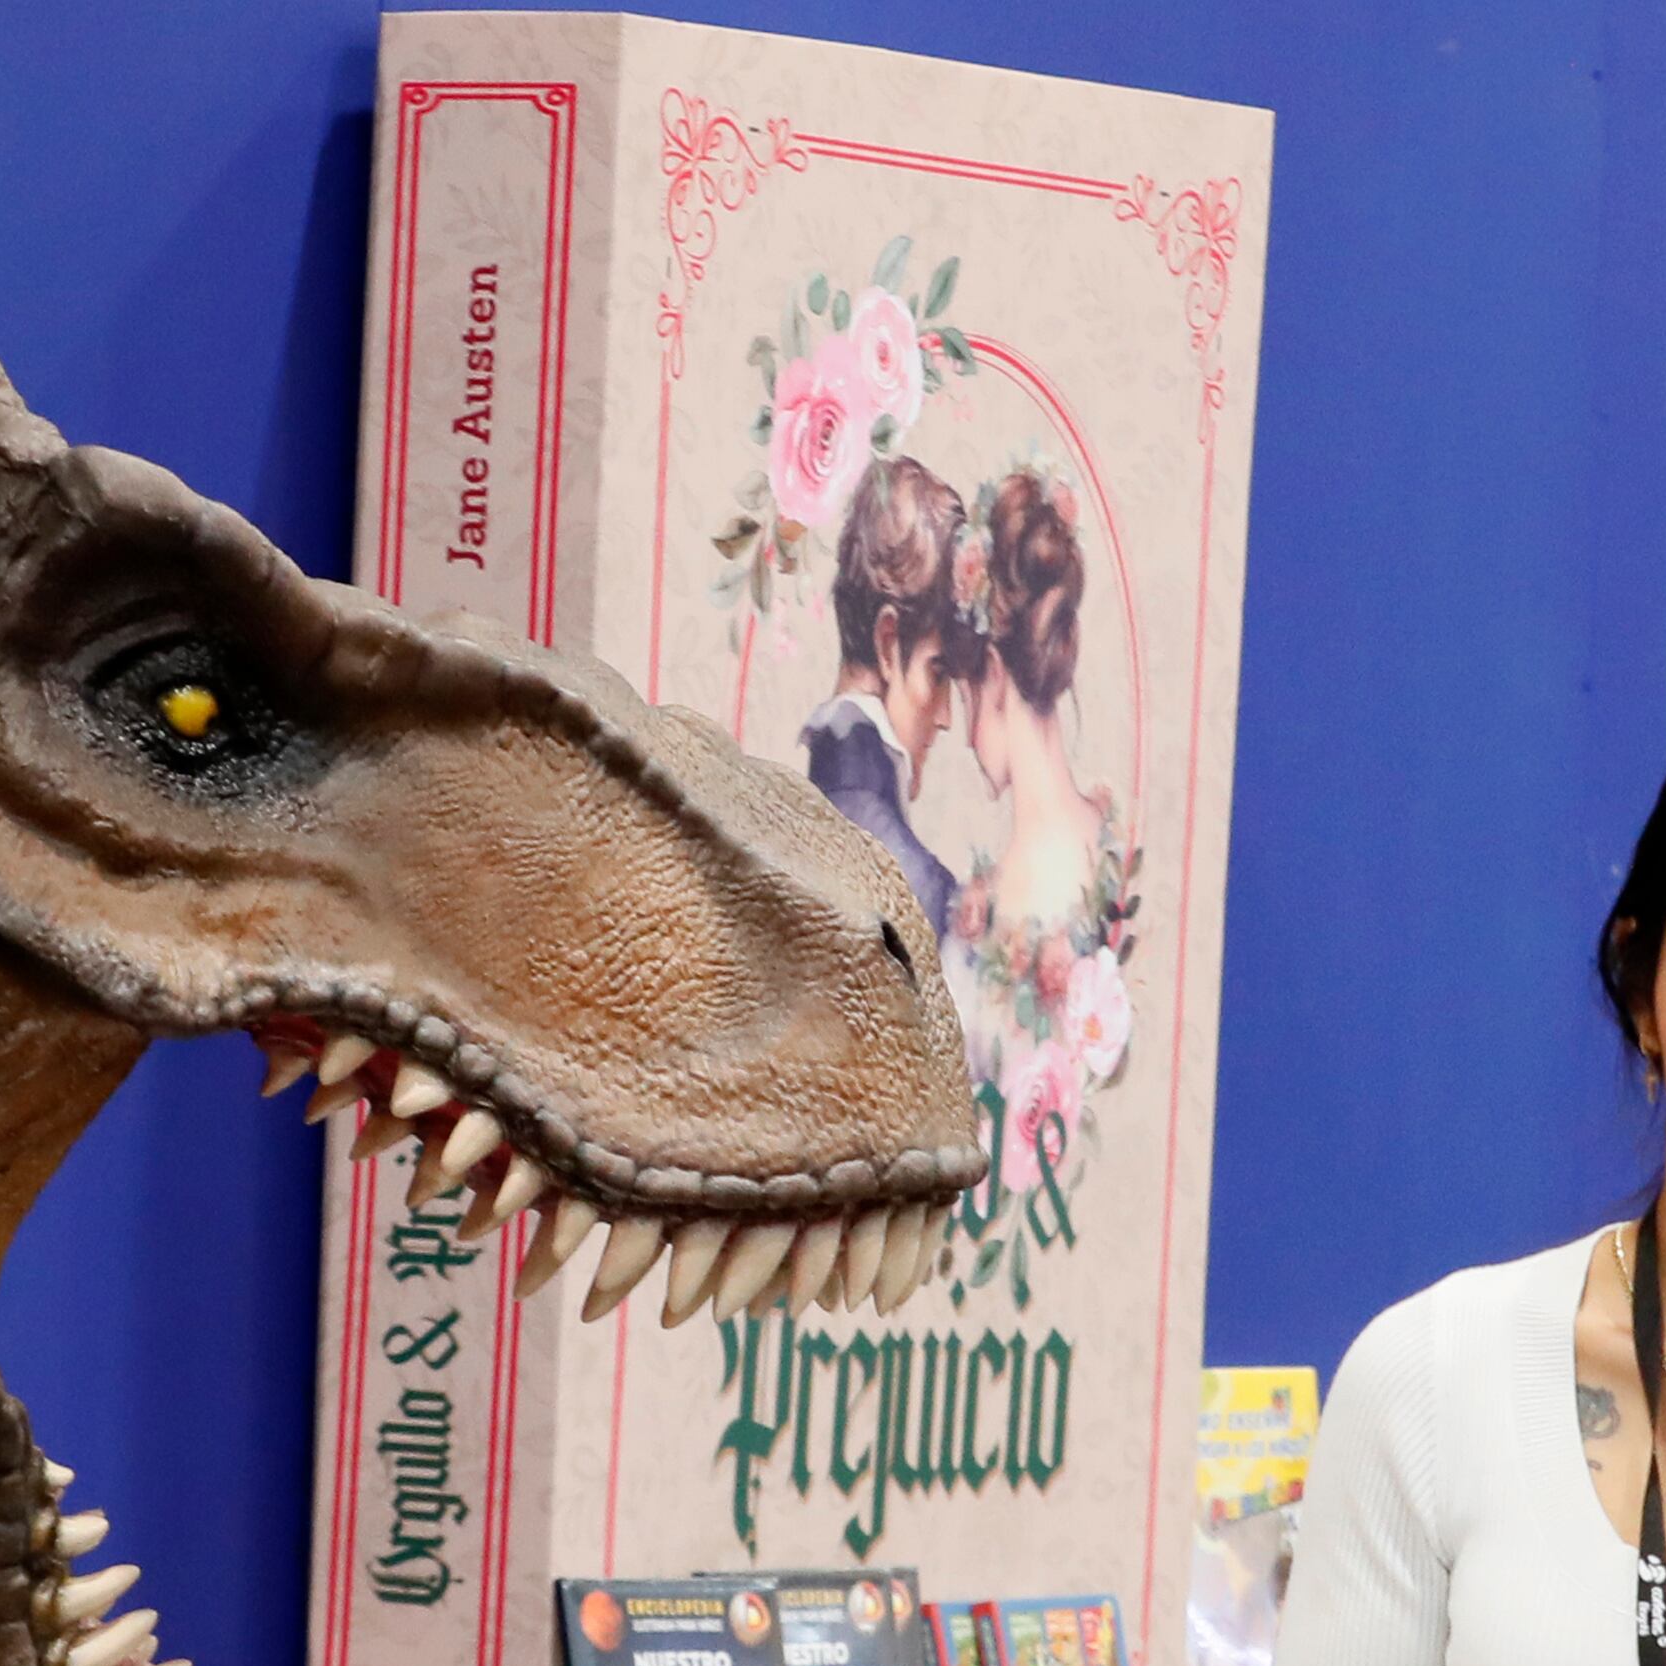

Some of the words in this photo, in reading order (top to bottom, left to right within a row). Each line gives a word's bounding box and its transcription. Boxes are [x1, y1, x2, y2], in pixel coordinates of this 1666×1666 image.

[452, 264, 500, 444] Austen
[447, 457, 490, 569] Jane
[383, 1307, 462, 1371] &
[713, 1295, 1075, 1562] Prejuicio
[365, 1388, 469, 1607] Orgullo
